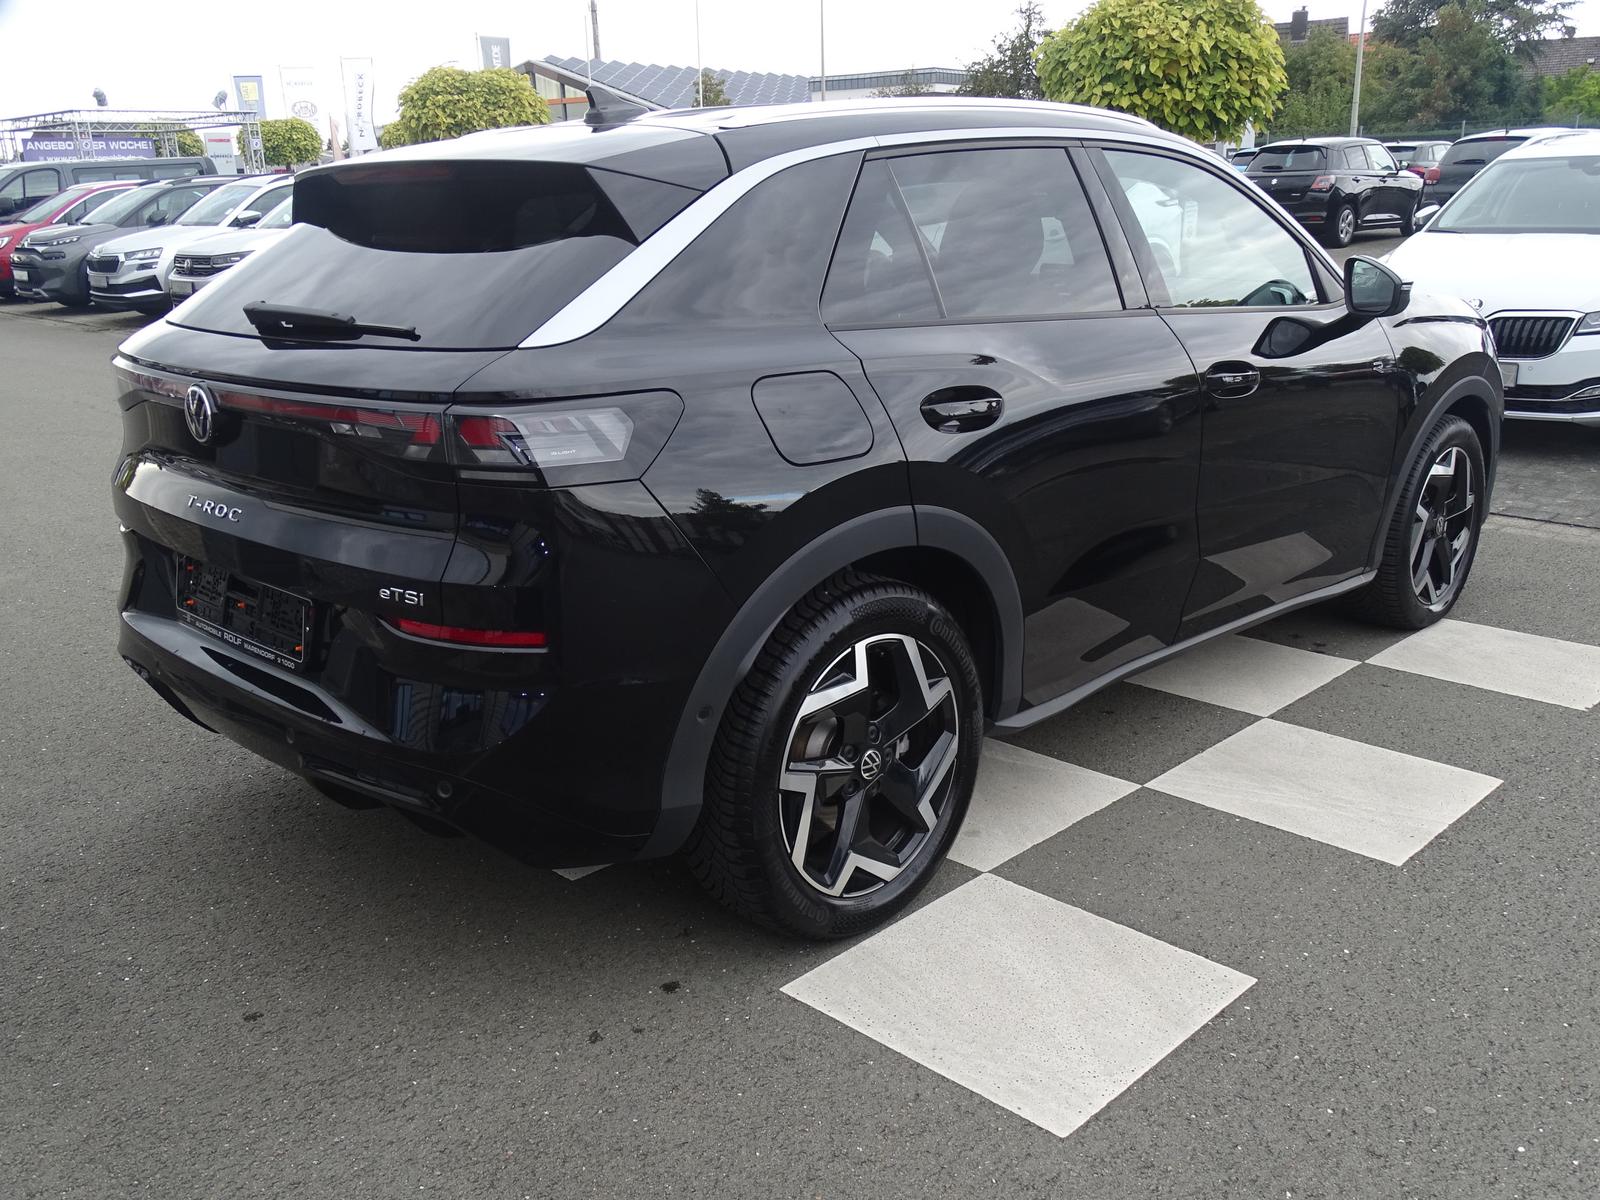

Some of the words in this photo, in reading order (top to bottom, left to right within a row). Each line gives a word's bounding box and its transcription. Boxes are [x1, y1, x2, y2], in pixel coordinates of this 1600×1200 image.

[26, 141, 81, 151] ANGEBO
[108, 141, 153, 150] WOCHE!
[187, 494, 242, 522] T-ROC
[223, 632, 242, 645] ROLF
